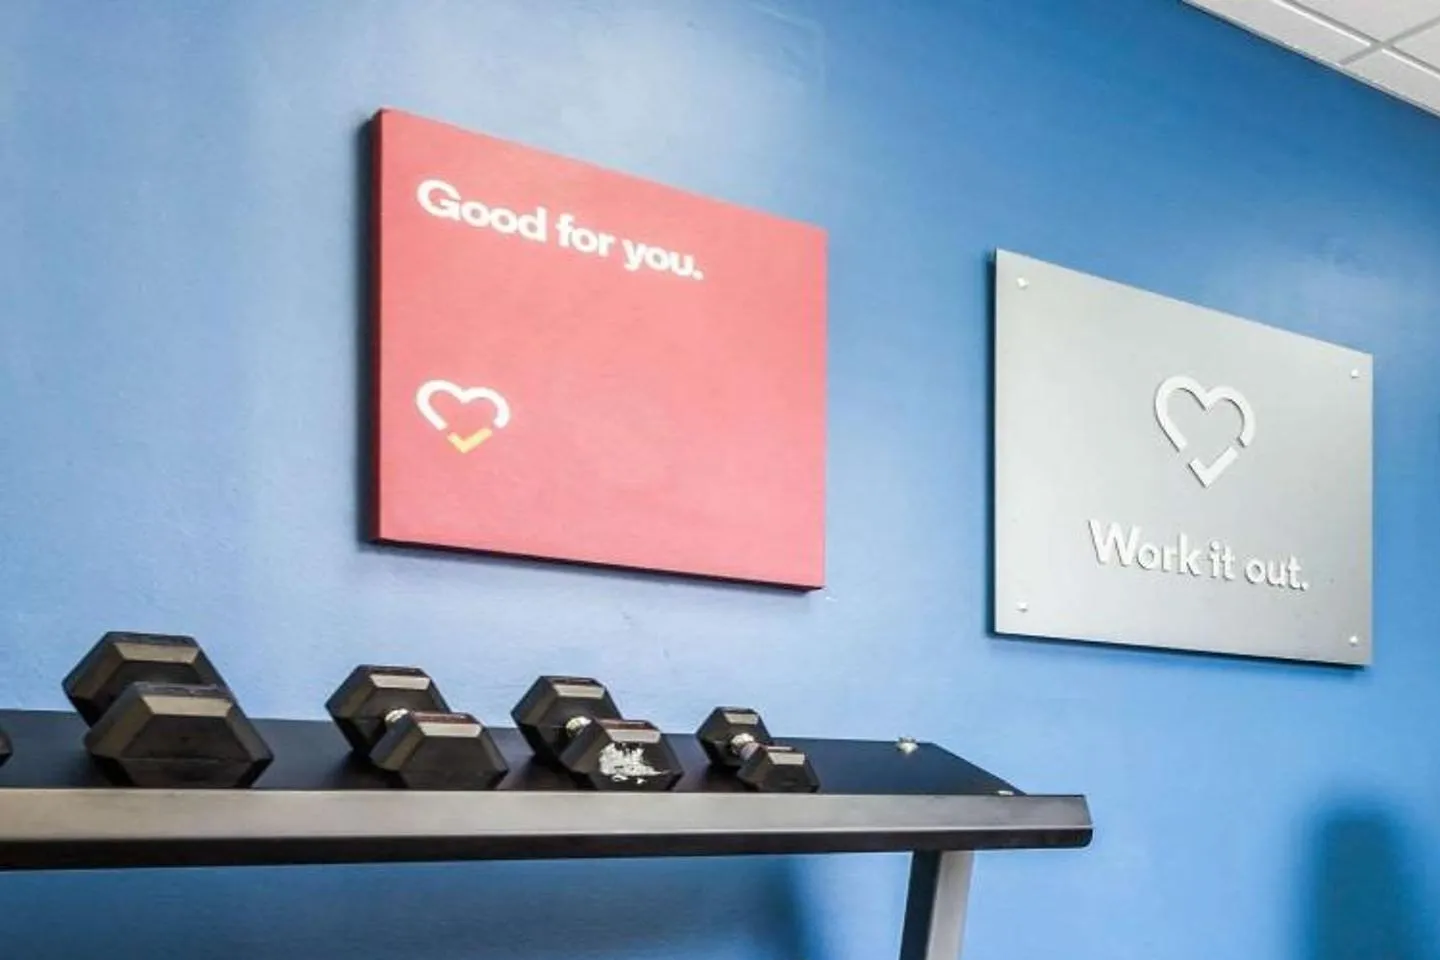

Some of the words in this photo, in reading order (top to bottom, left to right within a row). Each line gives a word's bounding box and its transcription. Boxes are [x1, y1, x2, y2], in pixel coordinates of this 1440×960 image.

[416, 179, 548, 242] Good
[556, 214, 615, 258] for
[622, 239, 704, 281] you.
[1088, 518, 1200, 576] Work
[1209, 541, 1236, 581] it
[1245, 556, 1309, 591] out.
